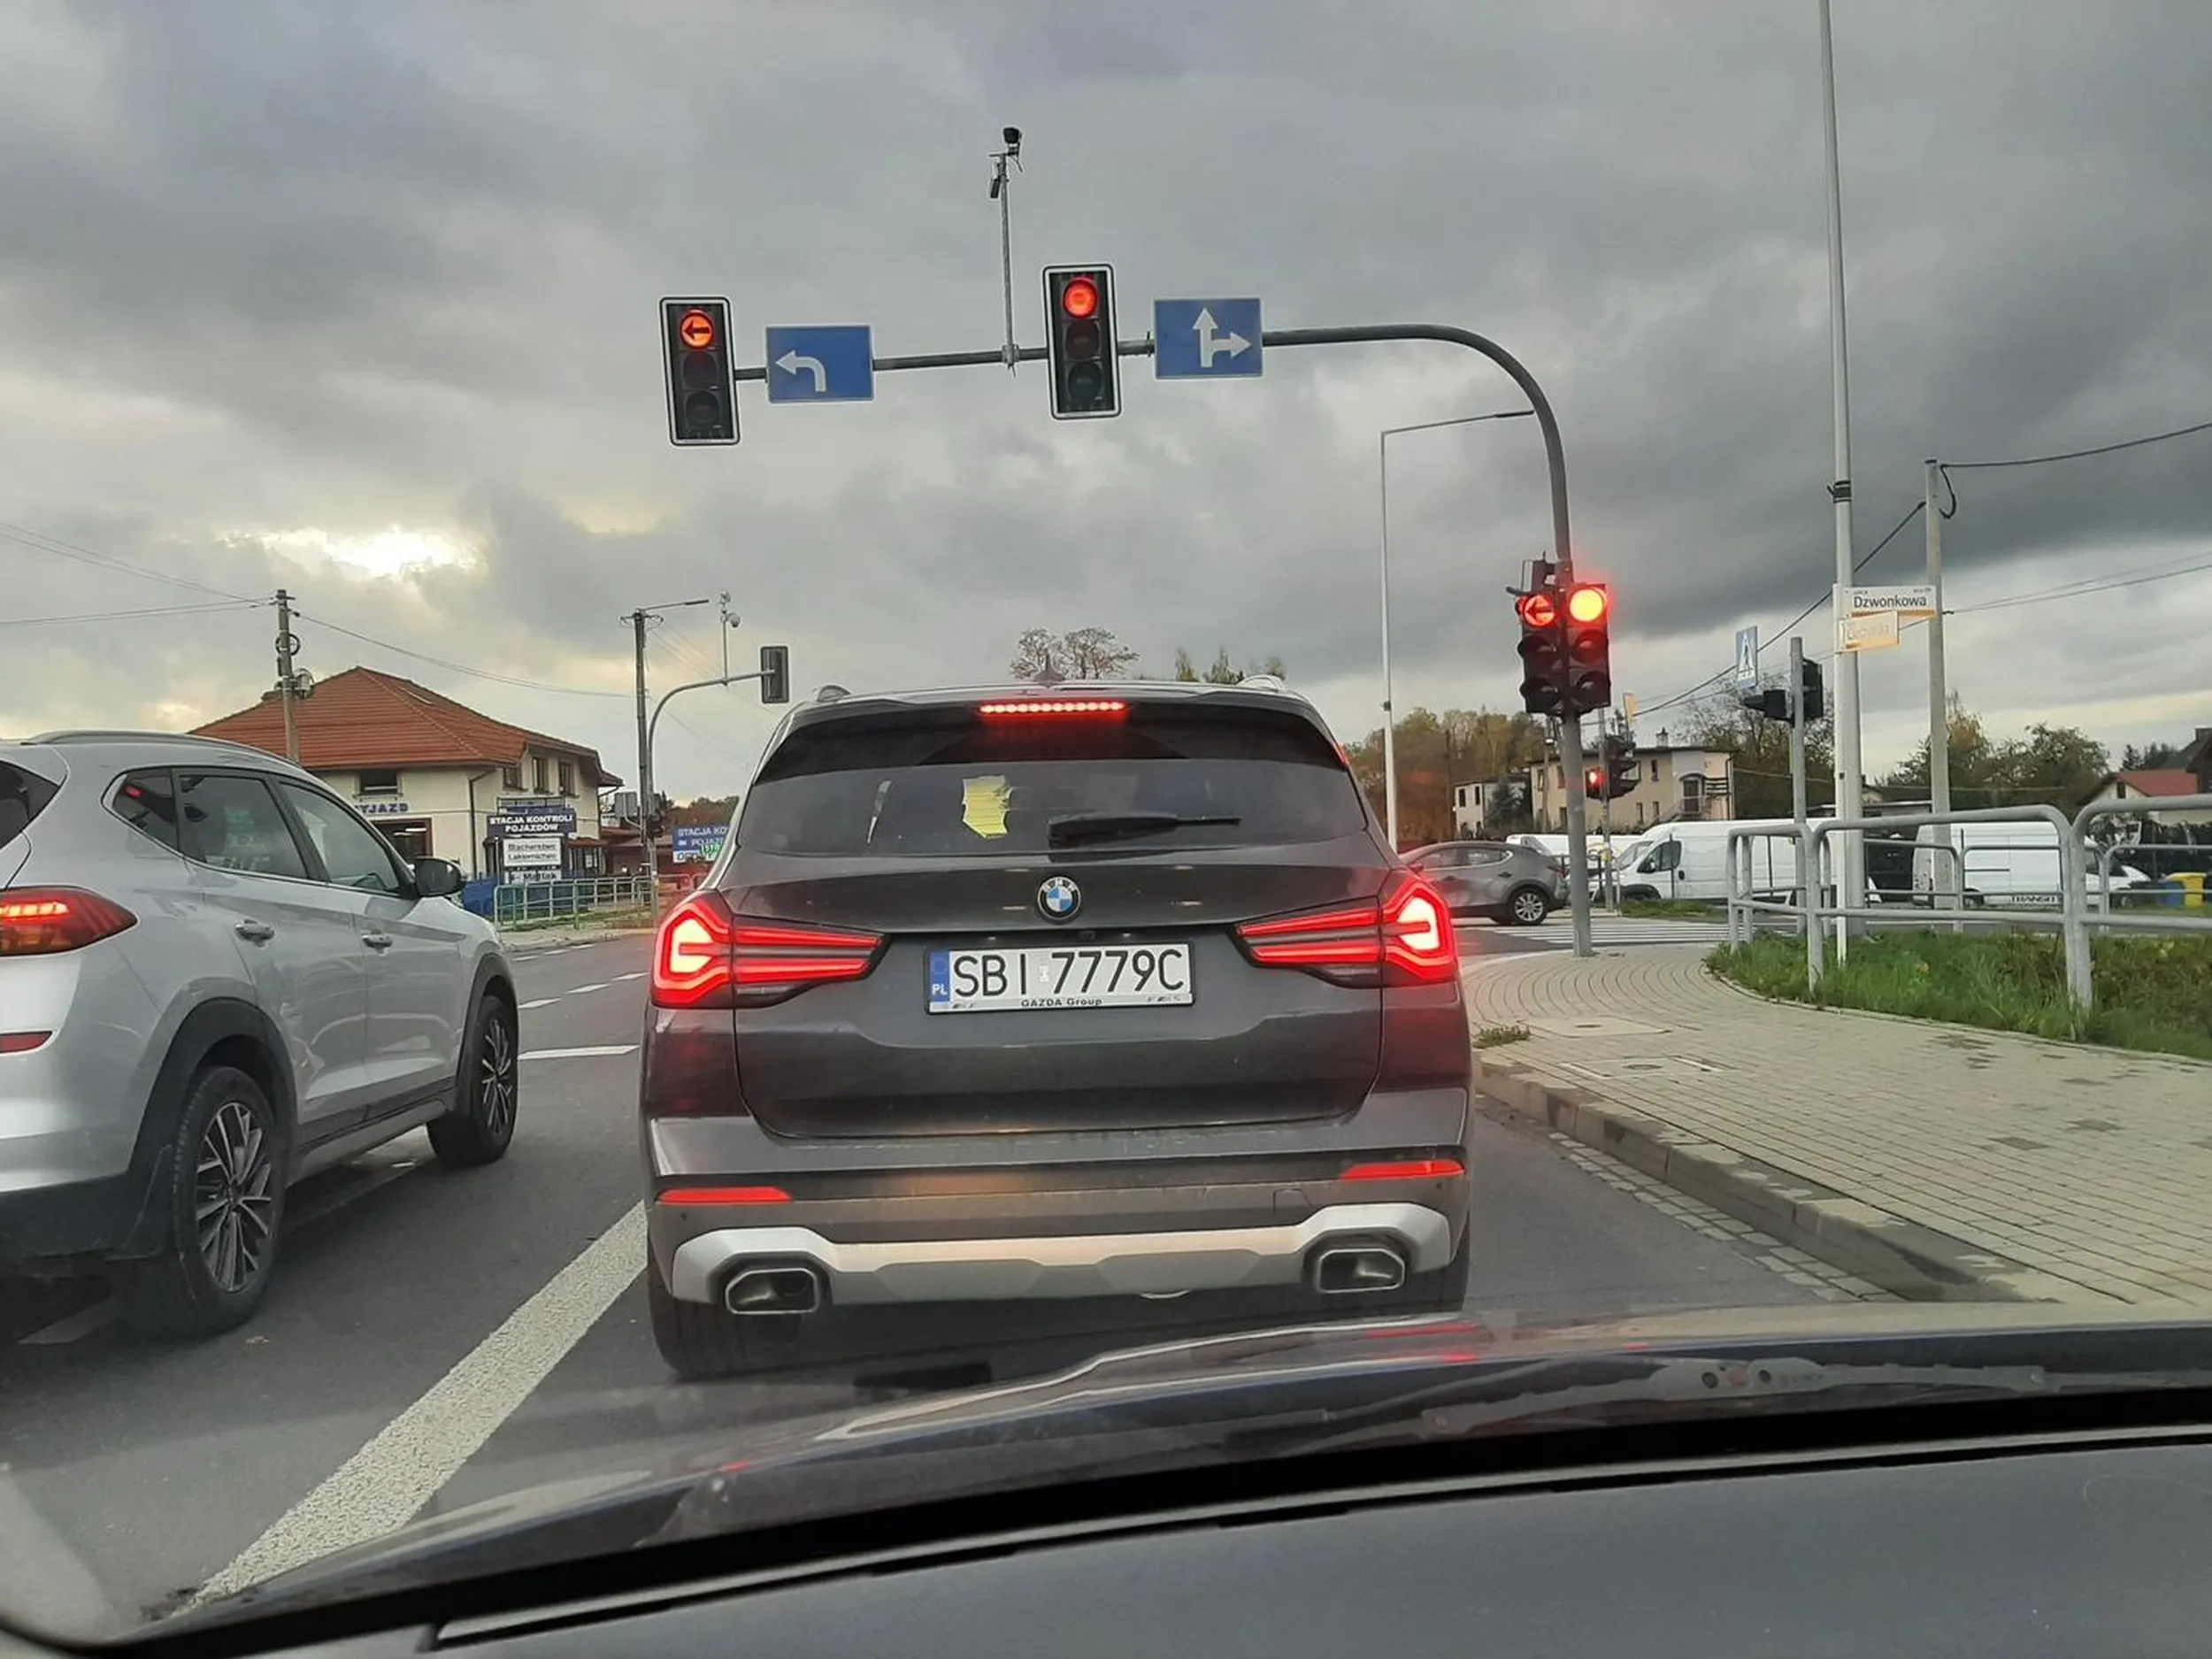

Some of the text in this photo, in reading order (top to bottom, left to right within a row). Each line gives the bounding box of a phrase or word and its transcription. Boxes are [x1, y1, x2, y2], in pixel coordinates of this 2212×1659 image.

[1854, 595, 1927, 609] Dzwonkowa
[355, 803, 409, 813] YJAZD
[489, 814, 573, 825] STACJA KONTROLI
[504, 823, 559, 833] POJAZDÓW
[953, 949, 1185, 997] SBI 7779C
[932, 984, 949, 995] PL
[1021, 997, 1103, 1008] GAZDA Group
